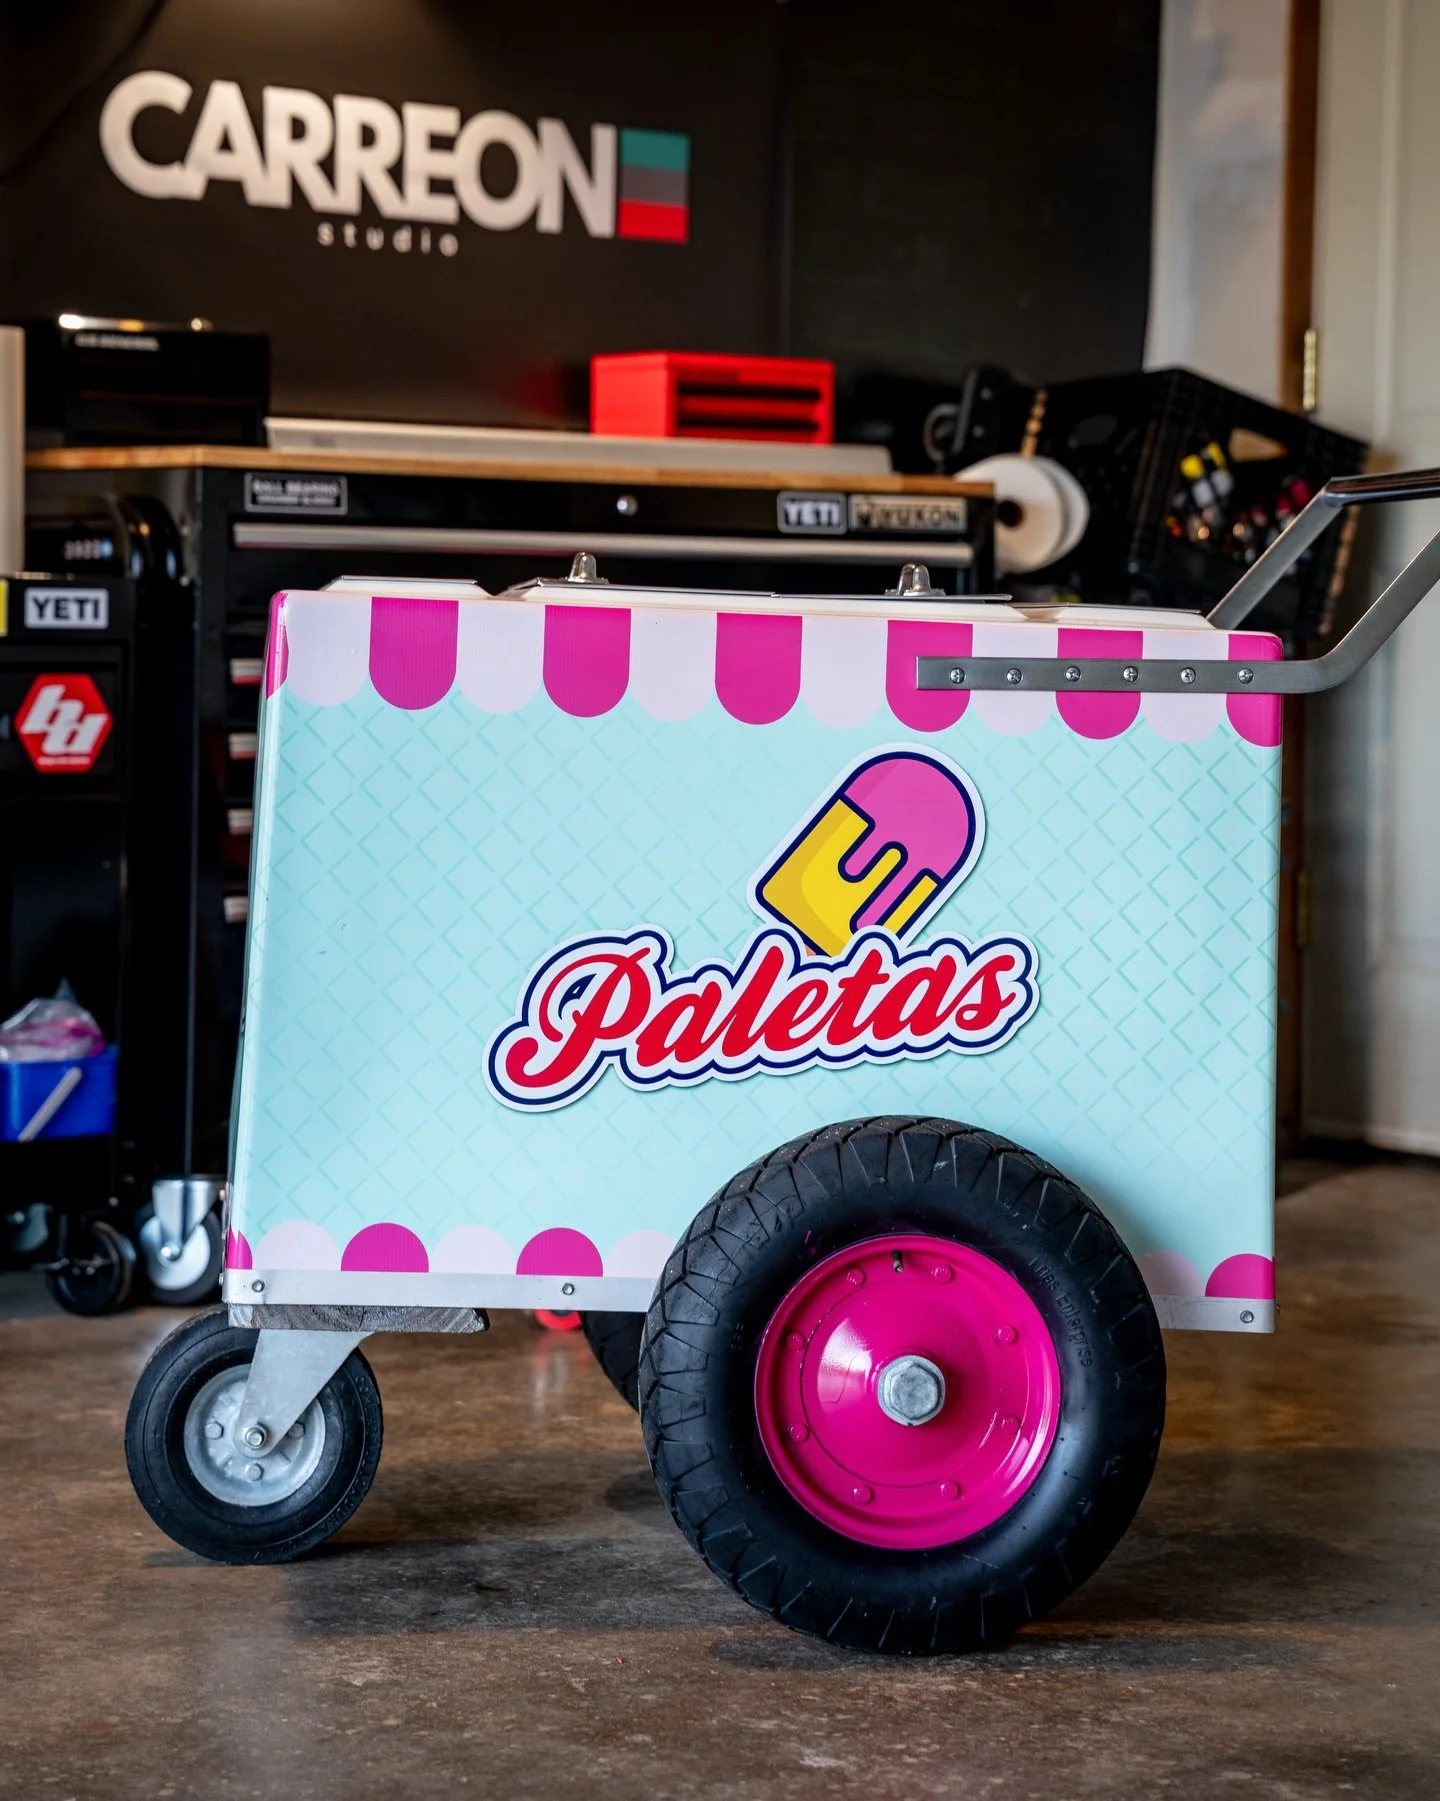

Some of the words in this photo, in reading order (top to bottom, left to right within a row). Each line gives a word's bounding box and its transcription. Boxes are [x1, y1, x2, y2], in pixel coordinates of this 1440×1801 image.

[100, 70, 617, 239] CARREON
[317, 221, 459, 258] studio
[783, 501, 842, 527] YETI
[33, 596, 100, 621] YETI
[505, 944, 1017, 1088] Paletas
